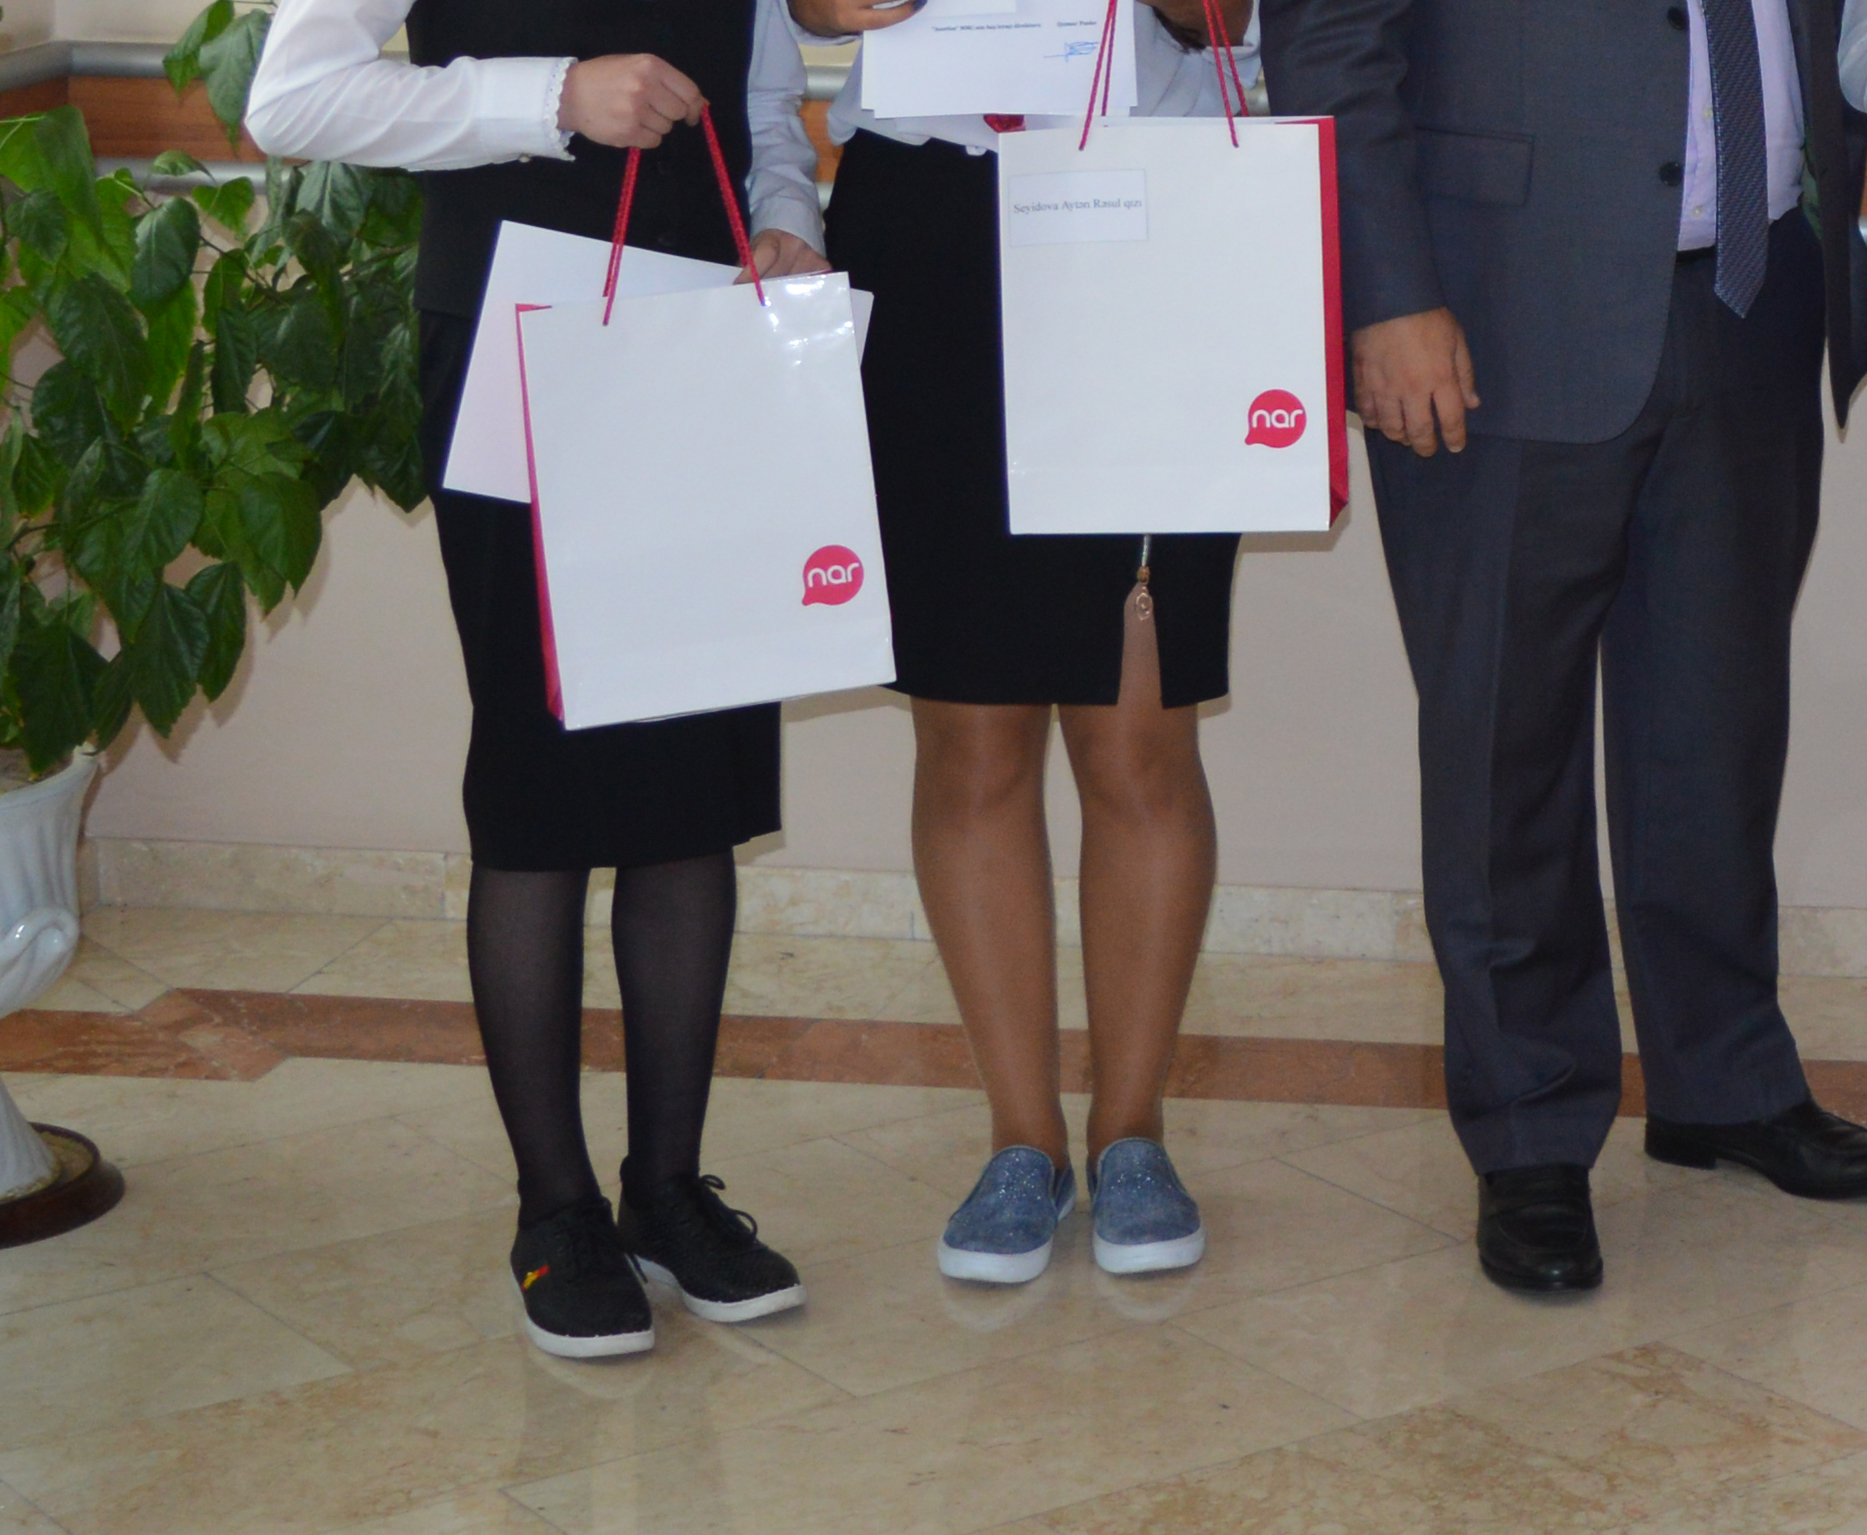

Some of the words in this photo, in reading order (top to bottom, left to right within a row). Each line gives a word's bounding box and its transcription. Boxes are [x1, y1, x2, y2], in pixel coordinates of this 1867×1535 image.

[1013, 202, 1058, 214] Seyidova
[1252, 409, 1304, 428] nar
[807, 562, 860, 588] nar
